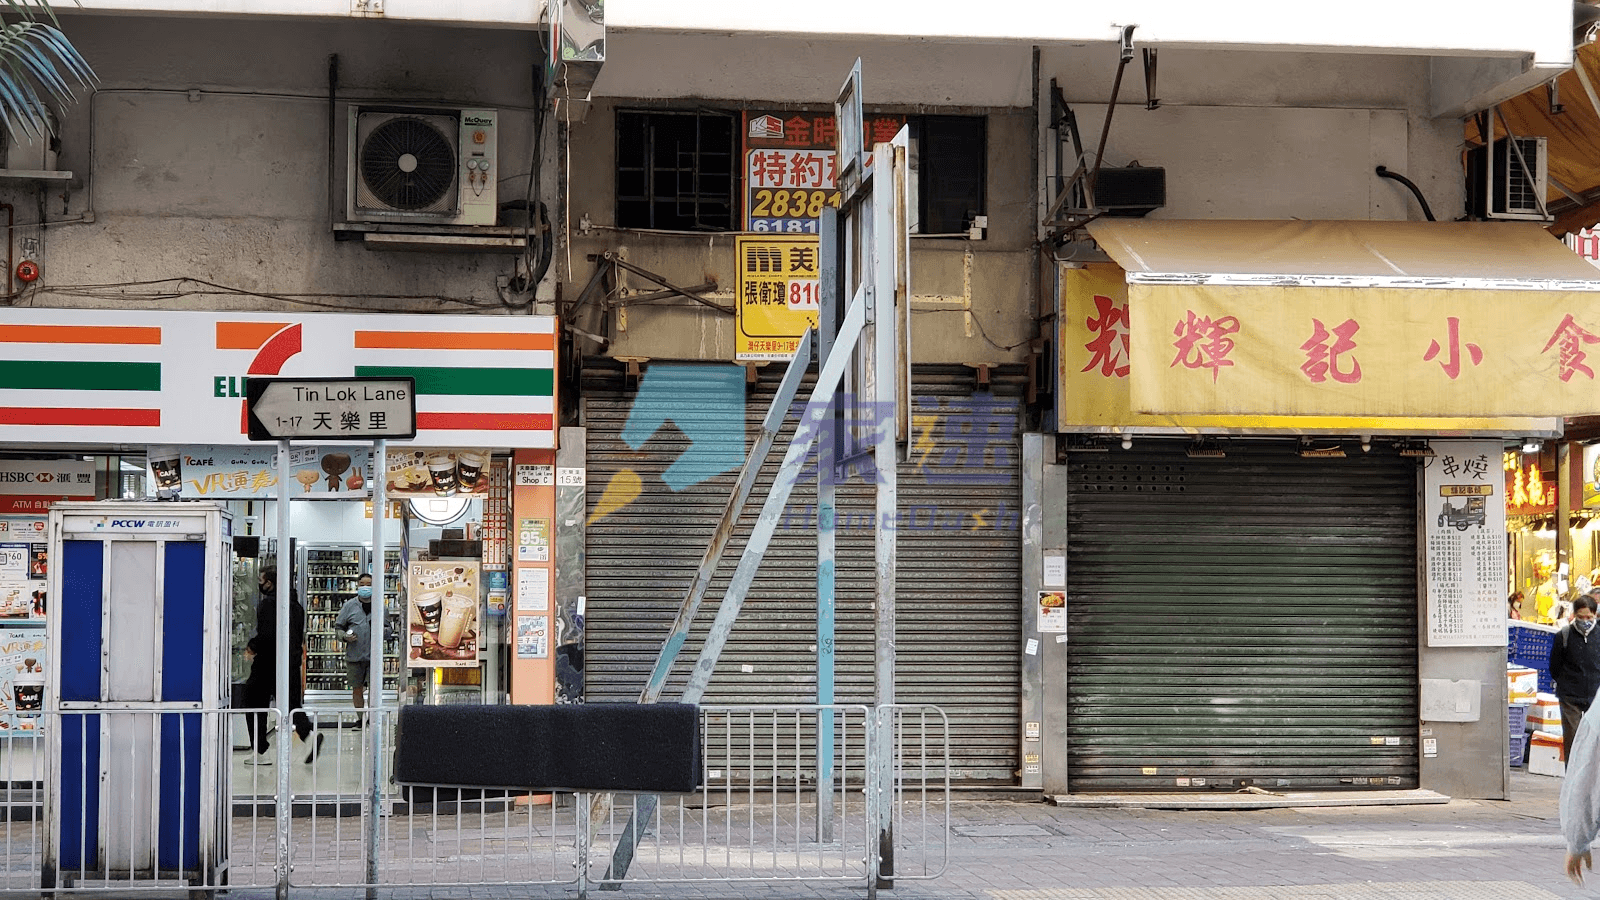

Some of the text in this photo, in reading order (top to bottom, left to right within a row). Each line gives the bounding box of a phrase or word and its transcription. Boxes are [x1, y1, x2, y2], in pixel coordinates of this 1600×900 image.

[785, 115, 899, 147] 金時業
[789, 246, 819, 272] 美
[1169, 310, 1600, 385] 輝記小食
[292, 386, 406, 402] Tin Lok Lane
[275, 411, 388, 431] 1-17 天樂里
[184, 456, 214, 467] 7CAFÉ
[1441, 454, 1489, 480] 串燒
[0, 471, 35, 483] HSBC
[522, 476, 548, 485] Shop C
[560, 475, 583, 485] 15號
[12, 500, 32, 509] ATM
[111, 519, 145, 528] PCCW
[8, 552, 22, 560] $60
